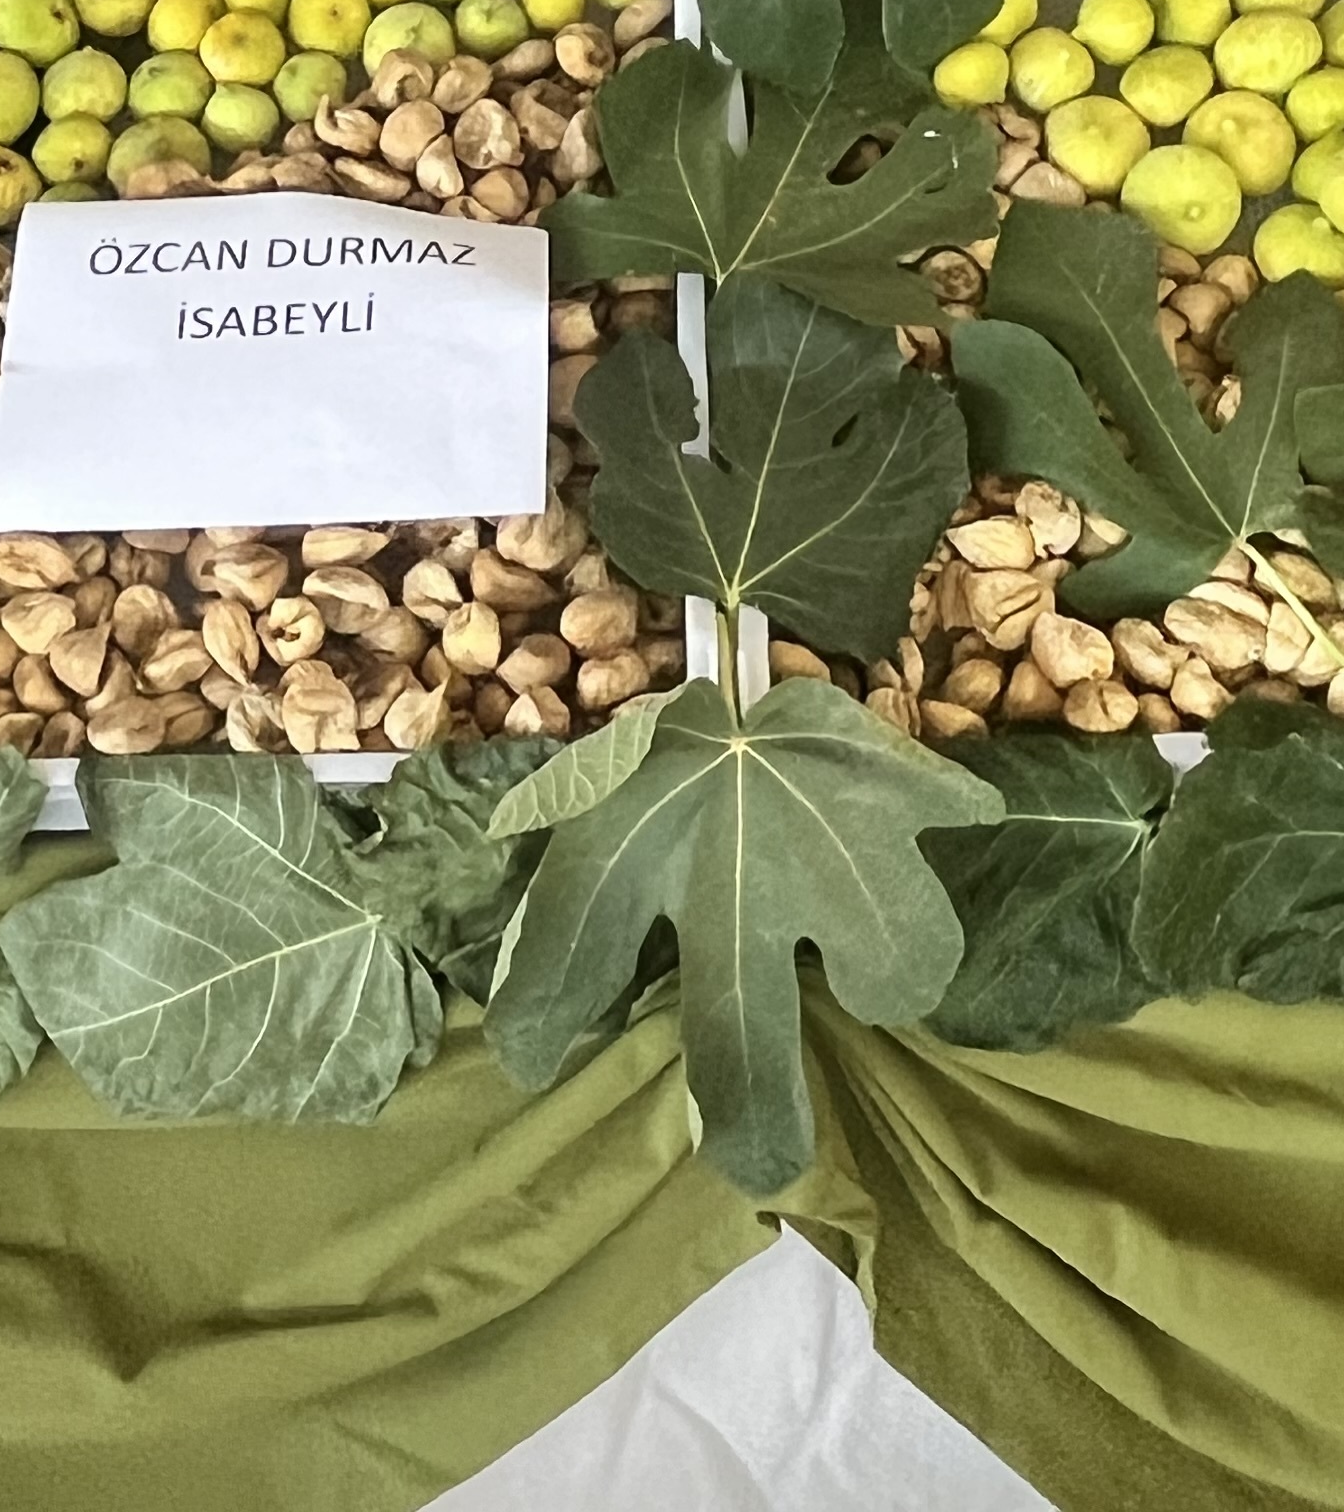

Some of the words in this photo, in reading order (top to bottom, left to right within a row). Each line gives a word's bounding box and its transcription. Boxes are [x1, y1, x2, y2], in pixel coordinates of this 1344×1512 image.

[89, 236, 248, 276] ÖZCAN
[266, 236, 479, 269] DURMAZ
[177, 291, 375, 340] İSABEYLİ
